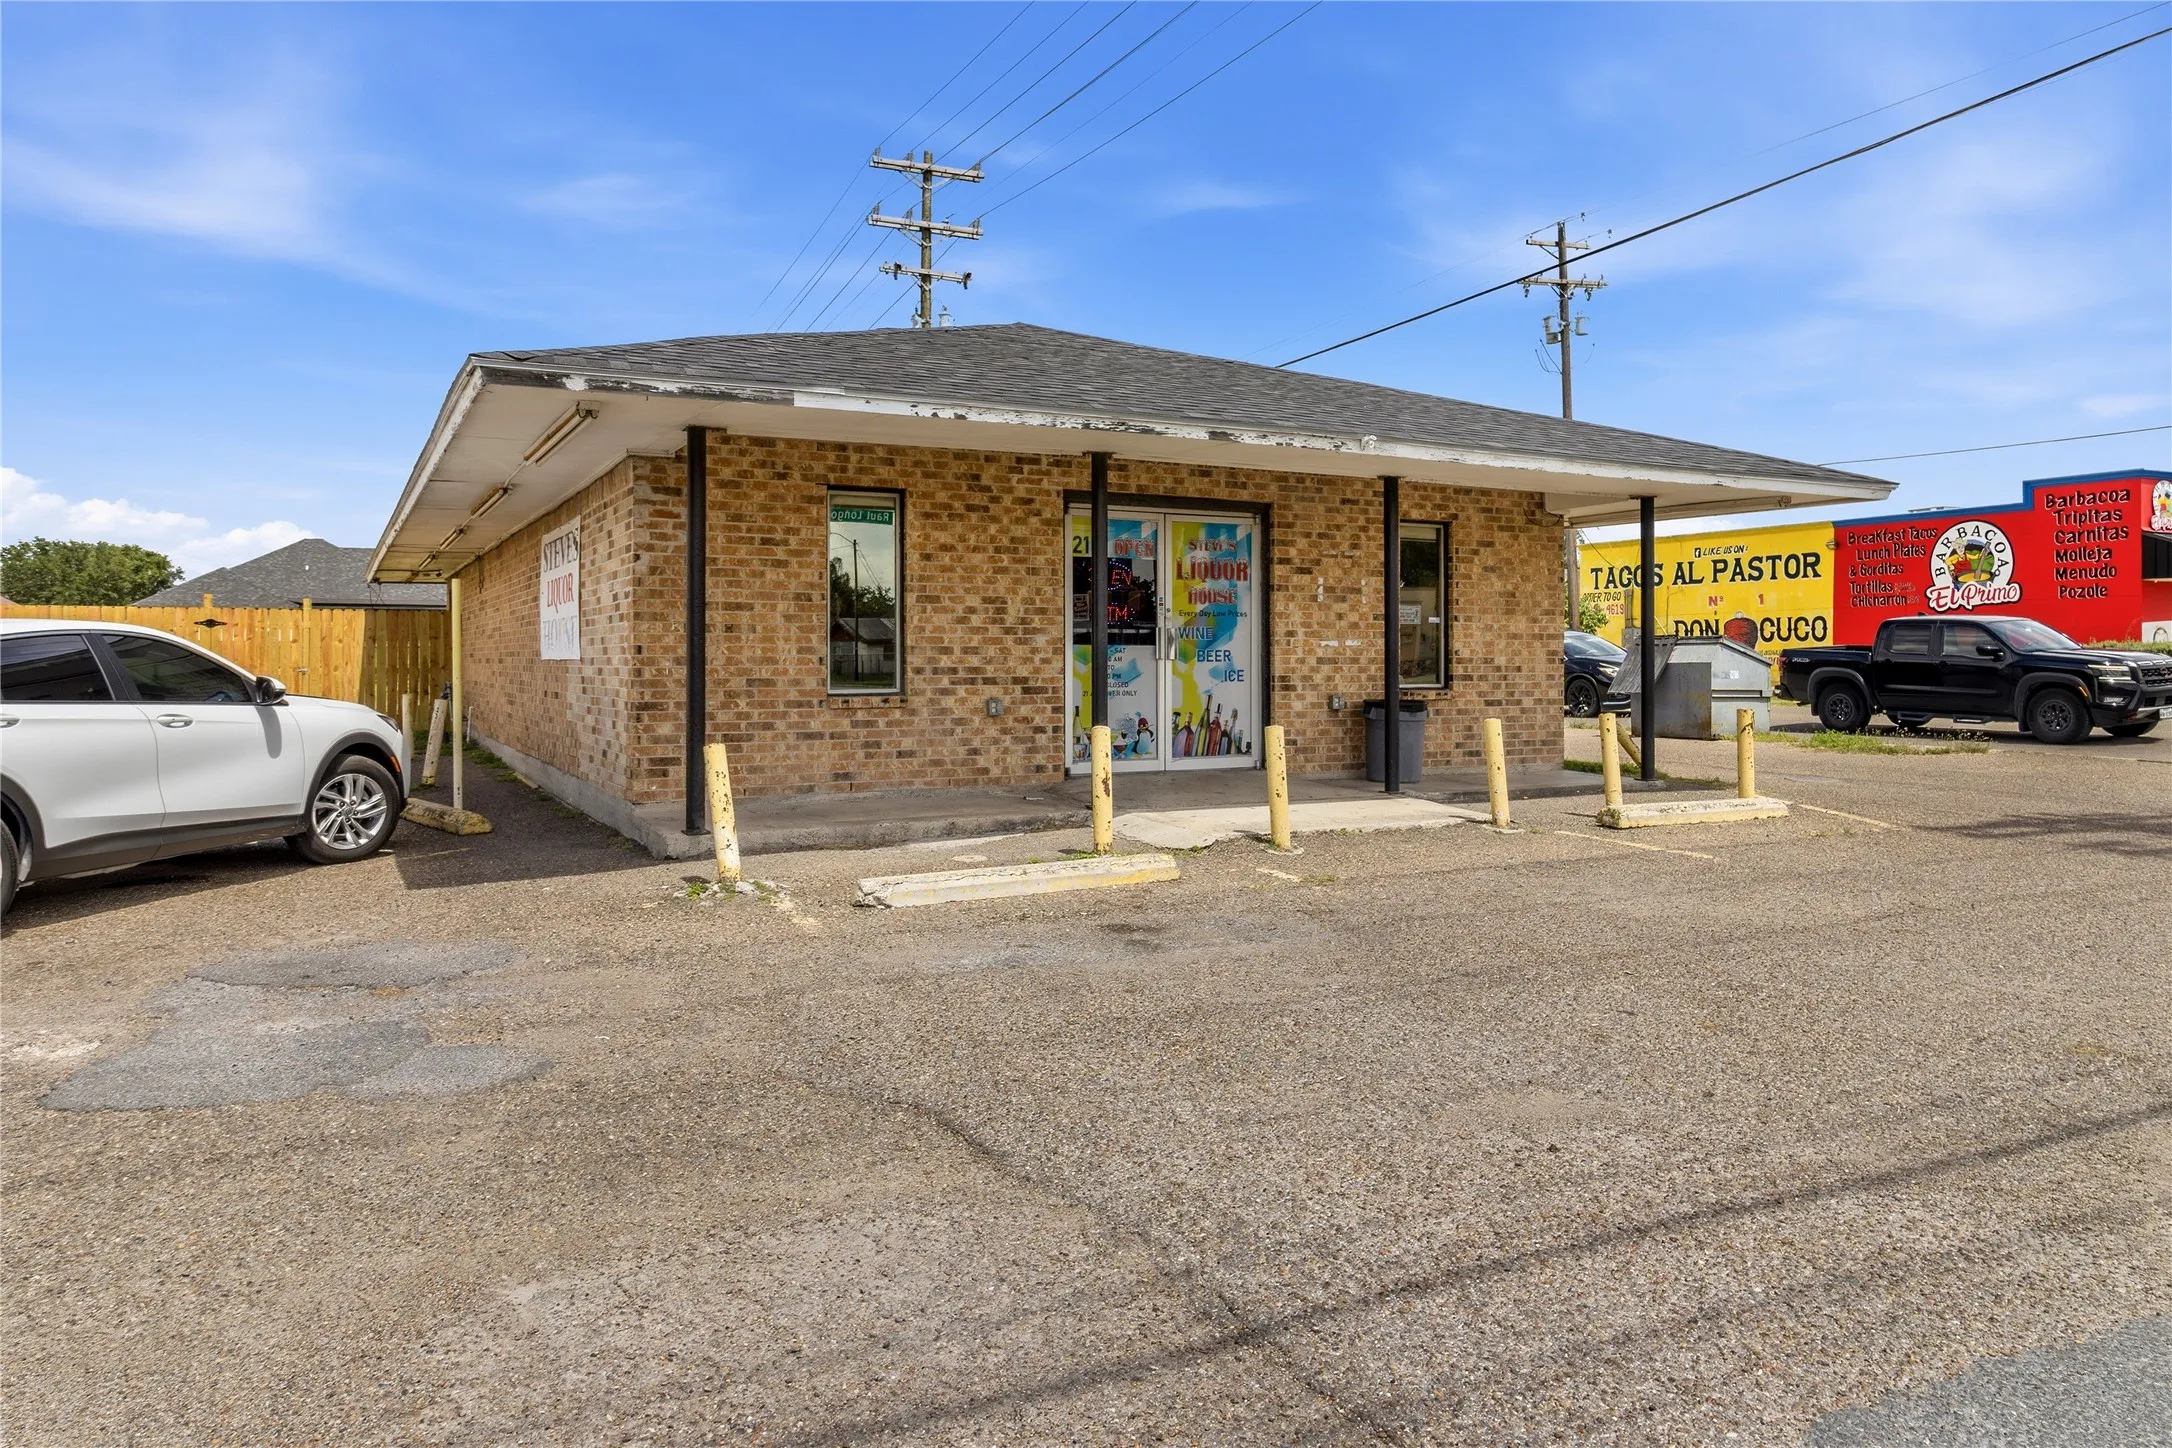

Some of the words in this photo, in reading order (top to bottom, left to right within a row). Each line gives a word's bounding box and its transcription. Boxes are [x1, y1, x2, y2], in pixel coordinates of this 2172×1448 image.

[2045, 489, 2130, 509] Barbacoa
[2052, 509, 2122, 528] Tripitas
[1909, 526, 1938, 541] Tacos
[2054, 526, 2129, 545] Carnitas
[1072, 536, 1089, 554] 21
[1113, 538, 1154, 557] OPEN
[1703, 547, 1721, 556] LIKE
[1723, 546, 1732, 555] US
[1856, 547, 1890, 561] Lunch
[1892, 543, 1926, 559] Plates
[1935, 525, 2010, 578] BARBACOA
[2054, 545, 2112, 564] Molleja
[1176, 558, 1249, 582] LIQUOR
[1672, 561, 1705, 585] AL
[1711, 552, 1821, 582] PASTOR
[1860, 562, 1904, 577] Gorditas
[2054, 563, 2117, 581] Menudo
[547, 573, 574, 613] LIQUOR
[1188, 588, 1237, 605] HOUSE
[1604, 592, 1611, 602] TO
[1612, 591, 1622, 601] GO
[1849, 580, 1894, 595] Tortillas
[1930, 586, 1960, 608] El
[1961, 583, 2017, 606] Primo
[2058, 583, 2108, 599] Pozole
[1758, 594, 1764, 605] 1
[1107, 605, 1128, 621] TM
[1179, 610, 1197, 618] Every
[1199, 610, 1211, 618] Day
[1179, 627, 1213, 640] WINE
[1674, 619, 1720, 636] DON
[1759, 616, 1828, 642] CUCO
[1197, 650, 1231, 662] BEER
[1224, 670, 1245, 682] ICE
